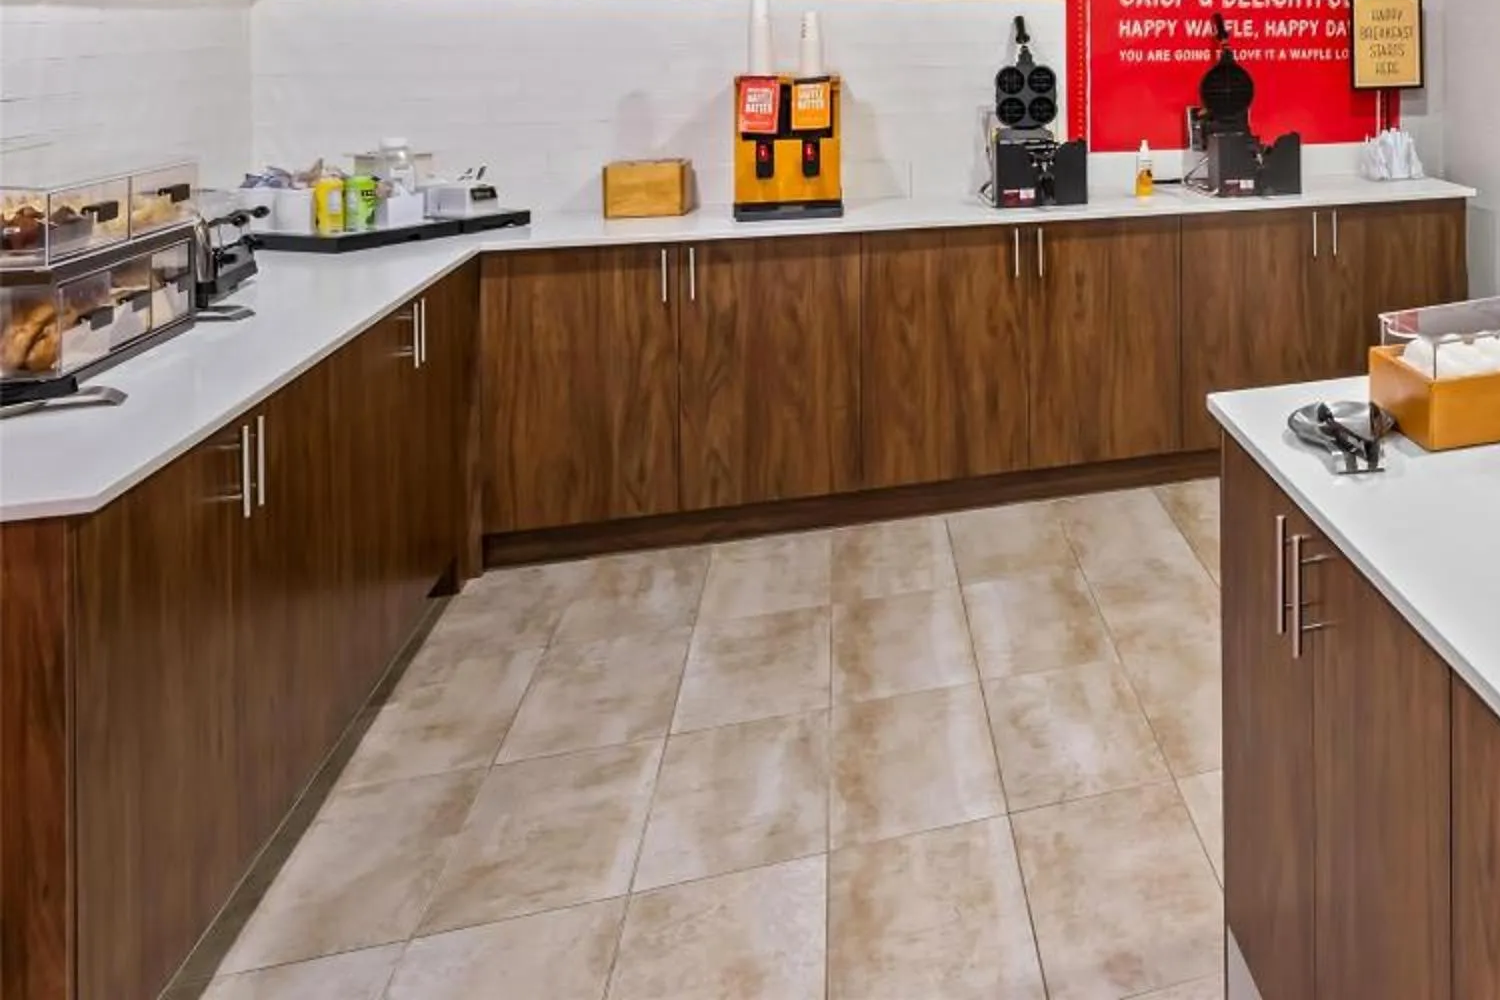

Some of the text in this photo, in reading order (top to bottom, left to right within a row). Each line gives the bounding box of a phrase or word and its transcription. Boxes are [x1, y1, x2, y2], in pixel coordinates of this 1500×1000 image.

[1118, 19, 1177, 38] HAPPY
[1264, 19, 1320, 38] HAPPY
[1325, 19, 1350, 38] DA
[1118, 49, 1143, 63] YOU
[1146, 49, 1172, 63] ARE
[1174, 49, 1212, 63] GOING
[1232, 48, 1262, 62] LOVE
[1265, 48, 1276, 62] IT
[1279, 49, 1288, 62] A
[1290, 49, 1333, 62] WAFFLE
